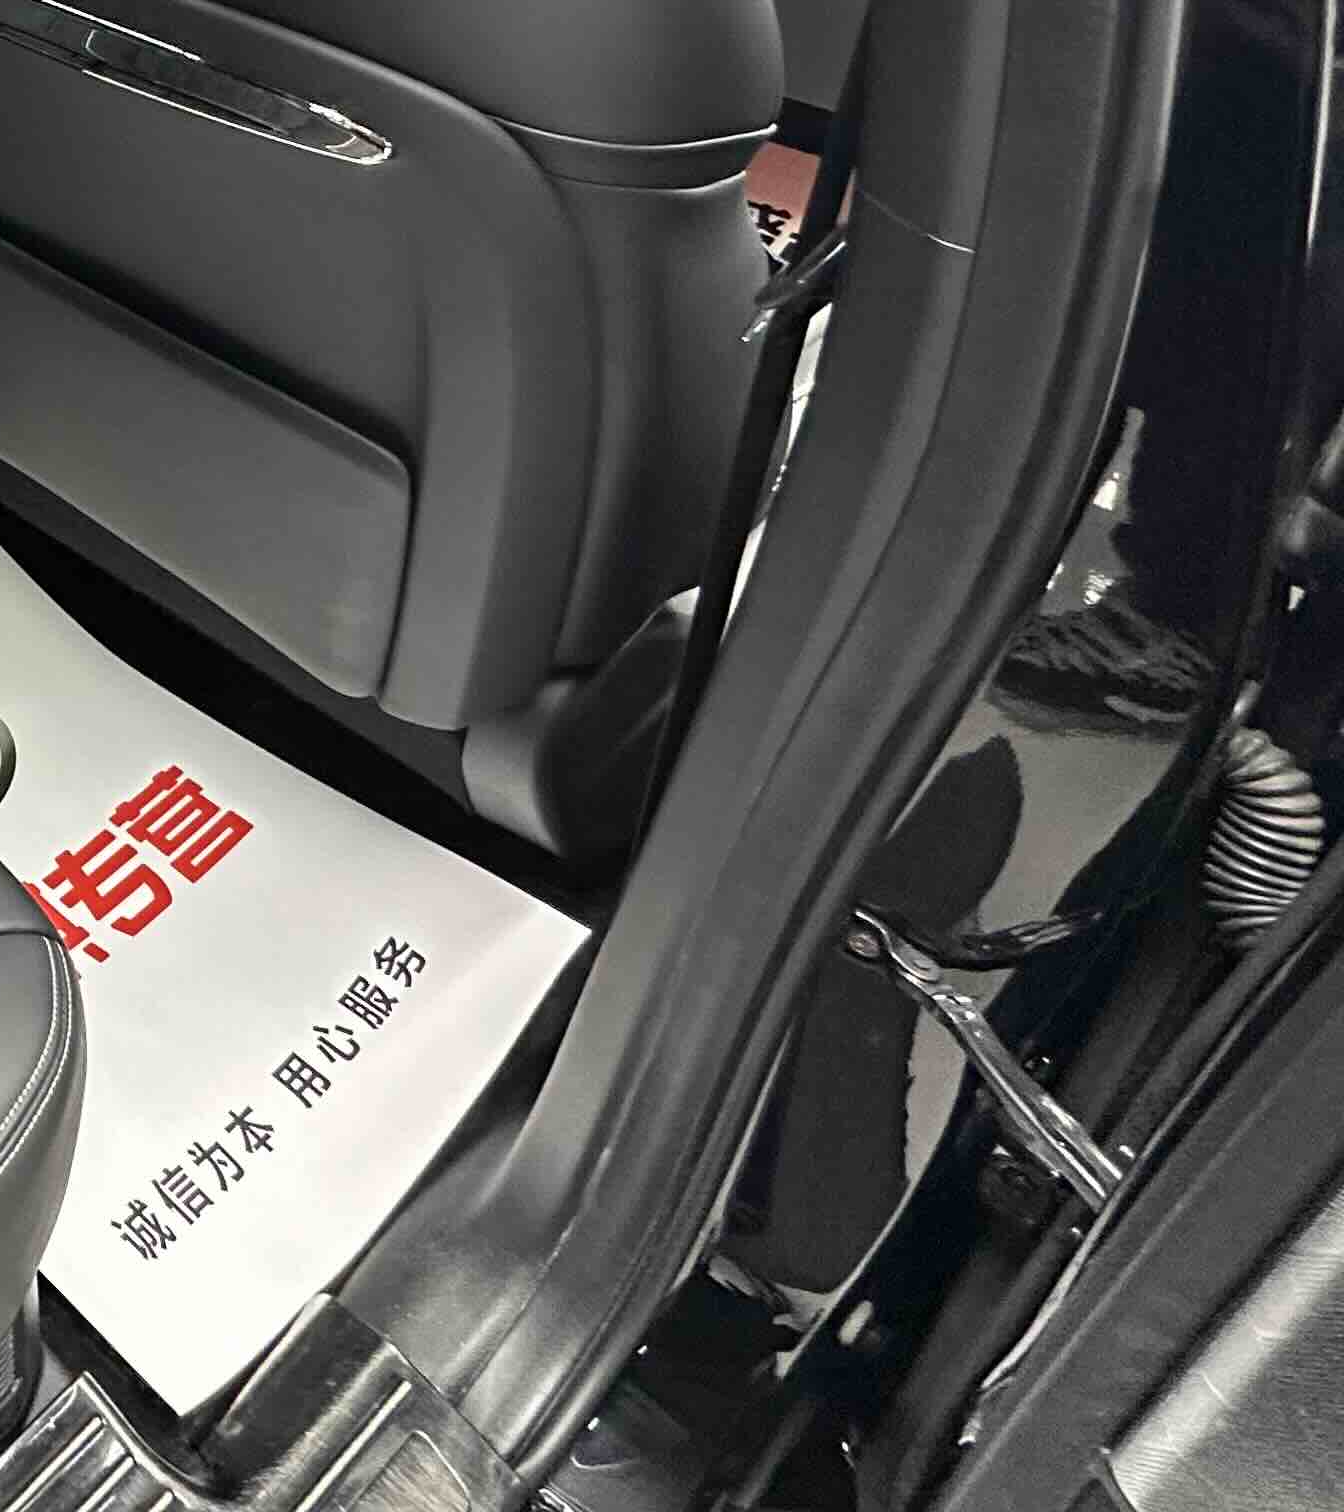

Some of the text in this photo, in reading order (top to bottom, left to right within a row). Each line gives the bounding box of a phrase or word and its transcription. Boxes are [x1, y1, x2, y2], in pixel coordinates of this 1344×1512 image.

[111, 935, 427, 1260] 诚信为本 用心服务
